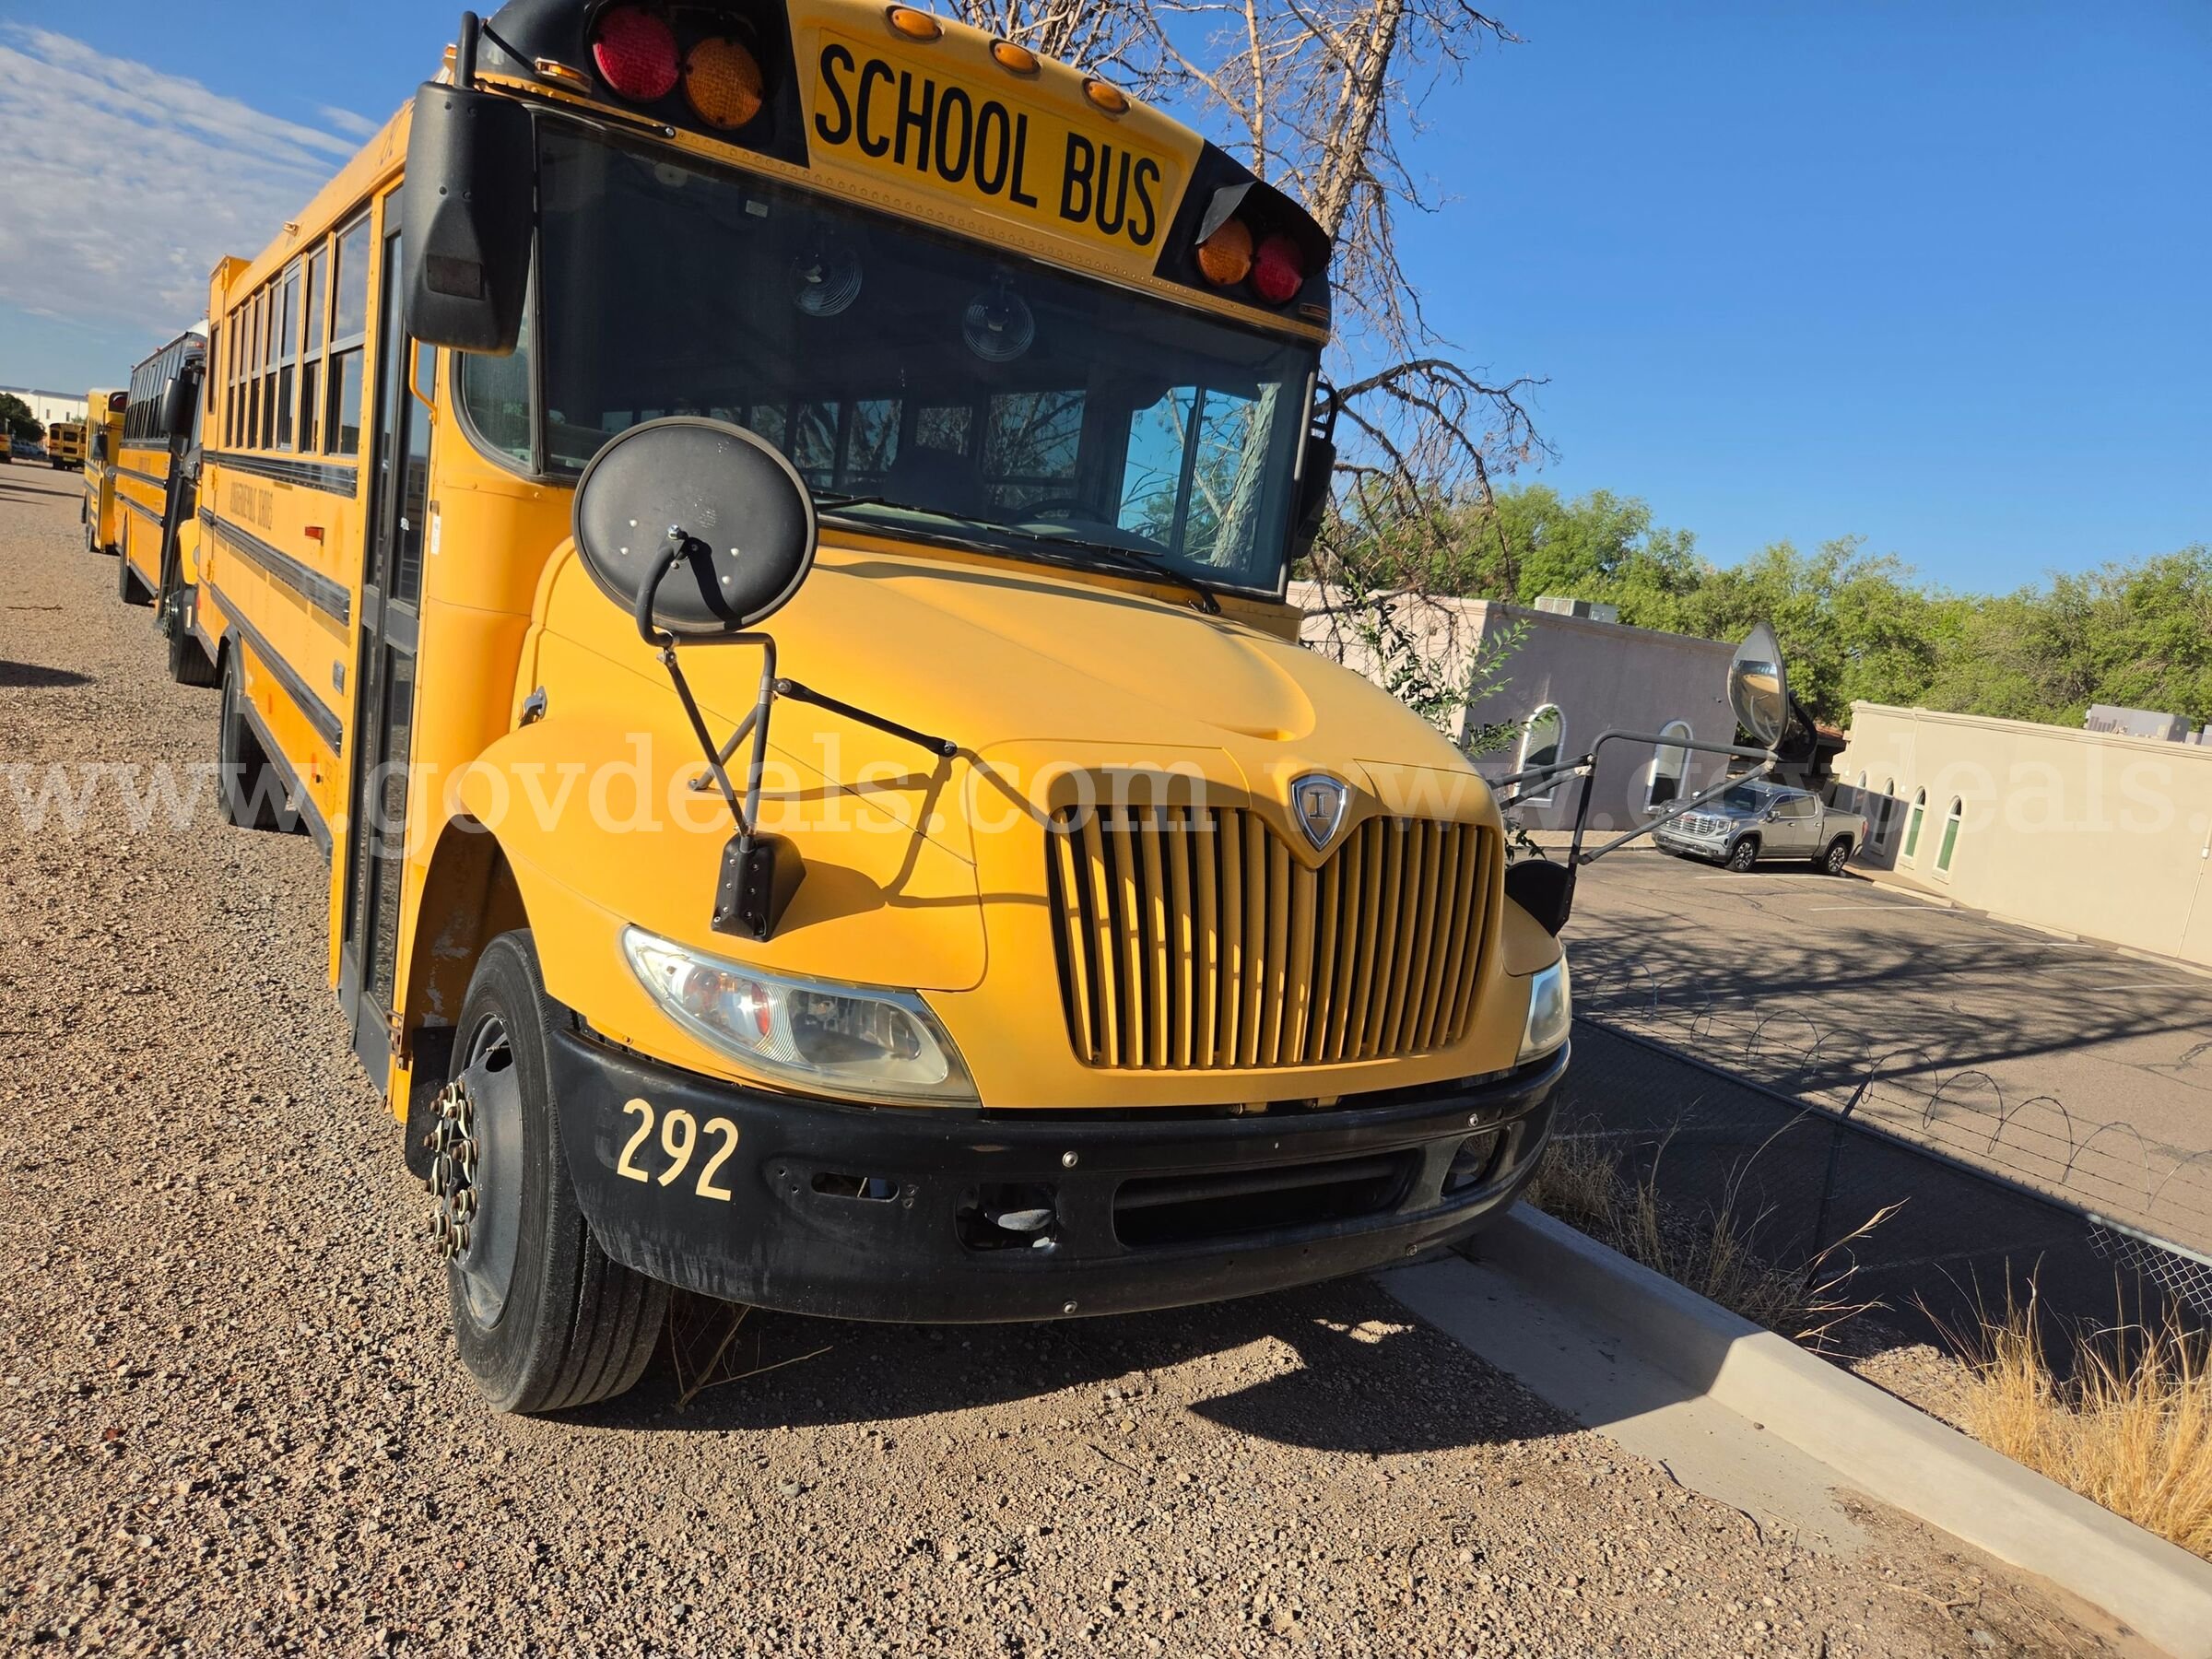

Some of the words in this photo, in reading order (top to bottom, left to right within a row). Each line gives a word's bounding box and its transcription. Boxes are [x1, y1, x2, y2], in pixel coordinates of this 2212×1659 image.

[815, 43, 1038, 209] SCHOOL
[1059, 132, 1161, 247] BUS
[617, 1098, 738, 1202] 292
